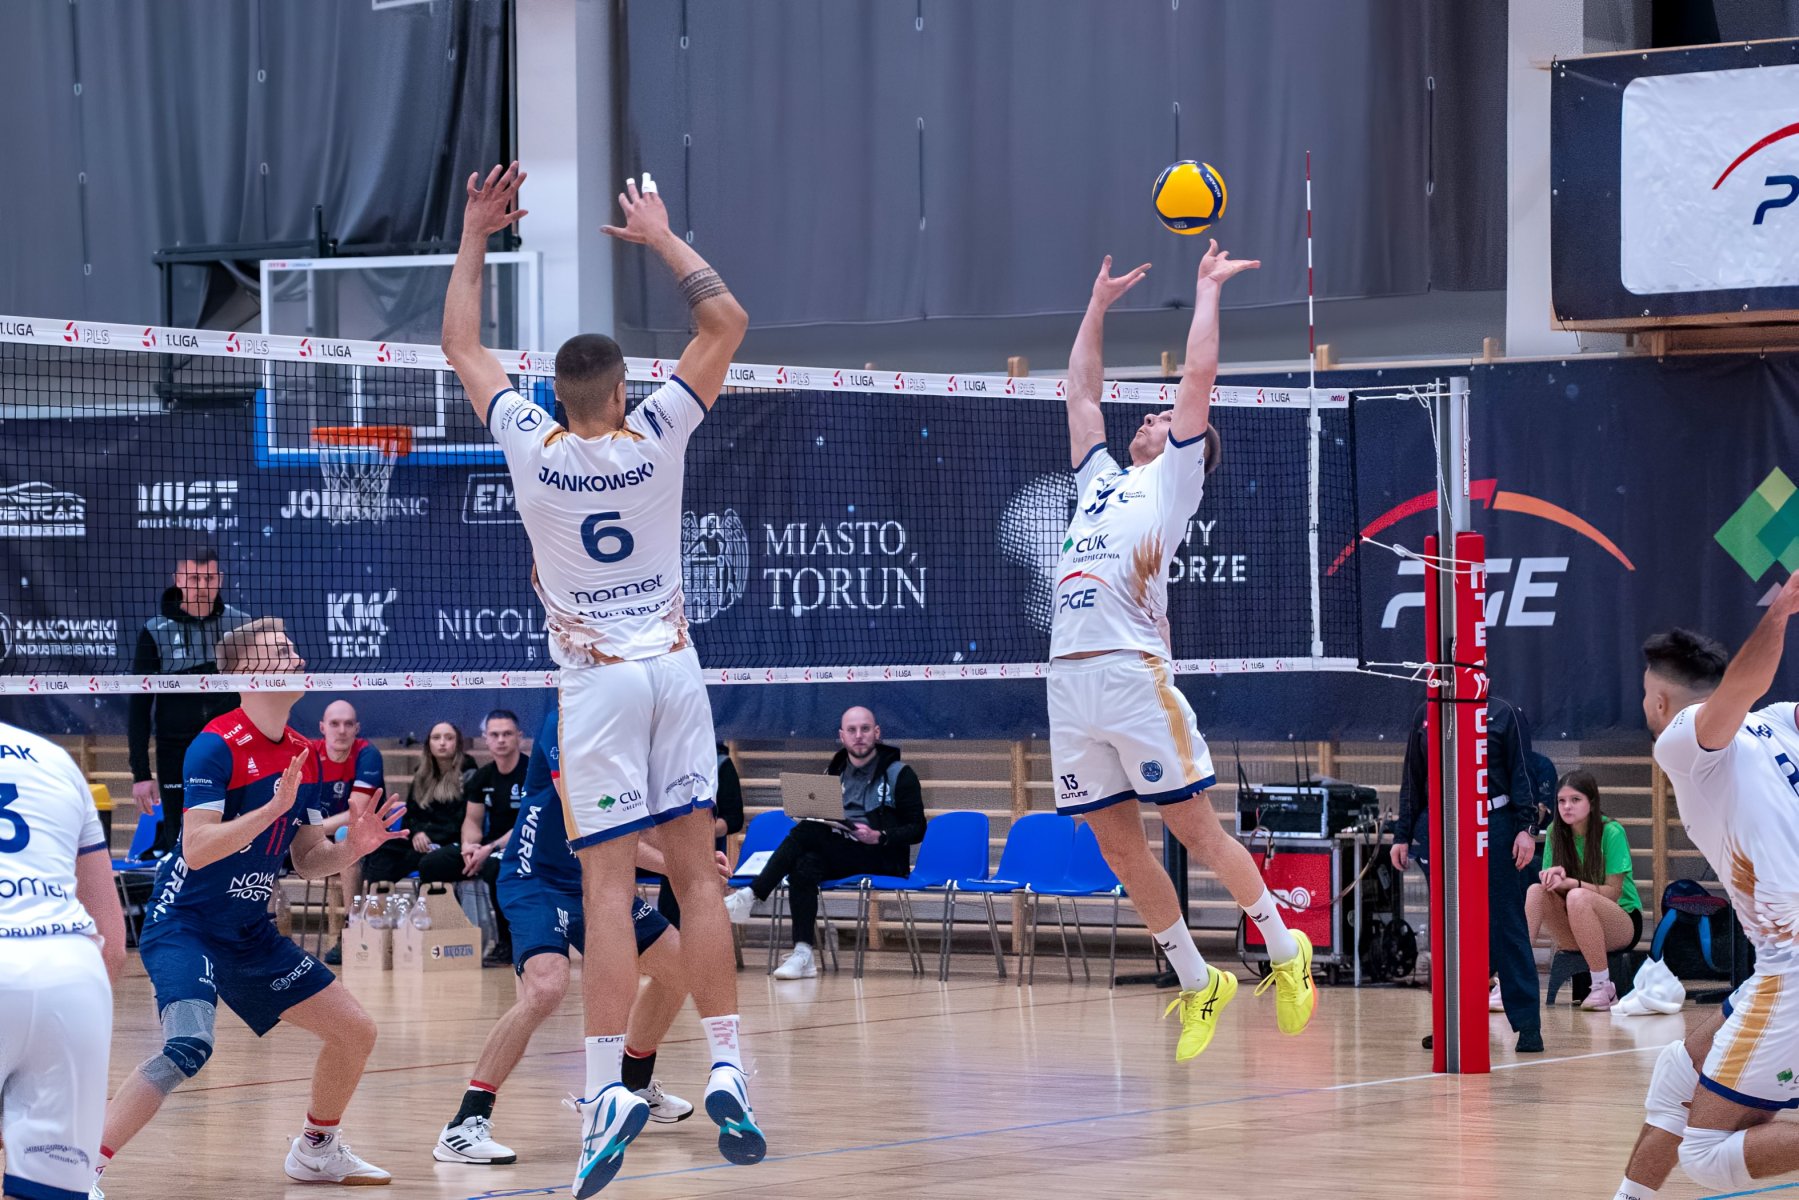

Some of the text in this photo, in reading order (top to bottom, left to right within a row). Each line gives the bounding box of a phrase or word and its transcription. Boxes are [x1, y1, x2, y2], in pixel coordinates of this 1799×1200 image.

[538, 462, 654, 493] JANKOWSKI
[580, 511, 634, 563] 6
[763, 520, 906, 556] MIASTO
[1076, 534, 1109, 553] CUK
[569, 574, 662, 604] nomet
[763, 553, 927, 610] TORUŃ
[1060, 588, 1097, 614] PGE
[16, 620, 116, 640] MAKOWSKI
[328, 636, 381, 658] TECH
[1061, 774, 1079, 791] 13
